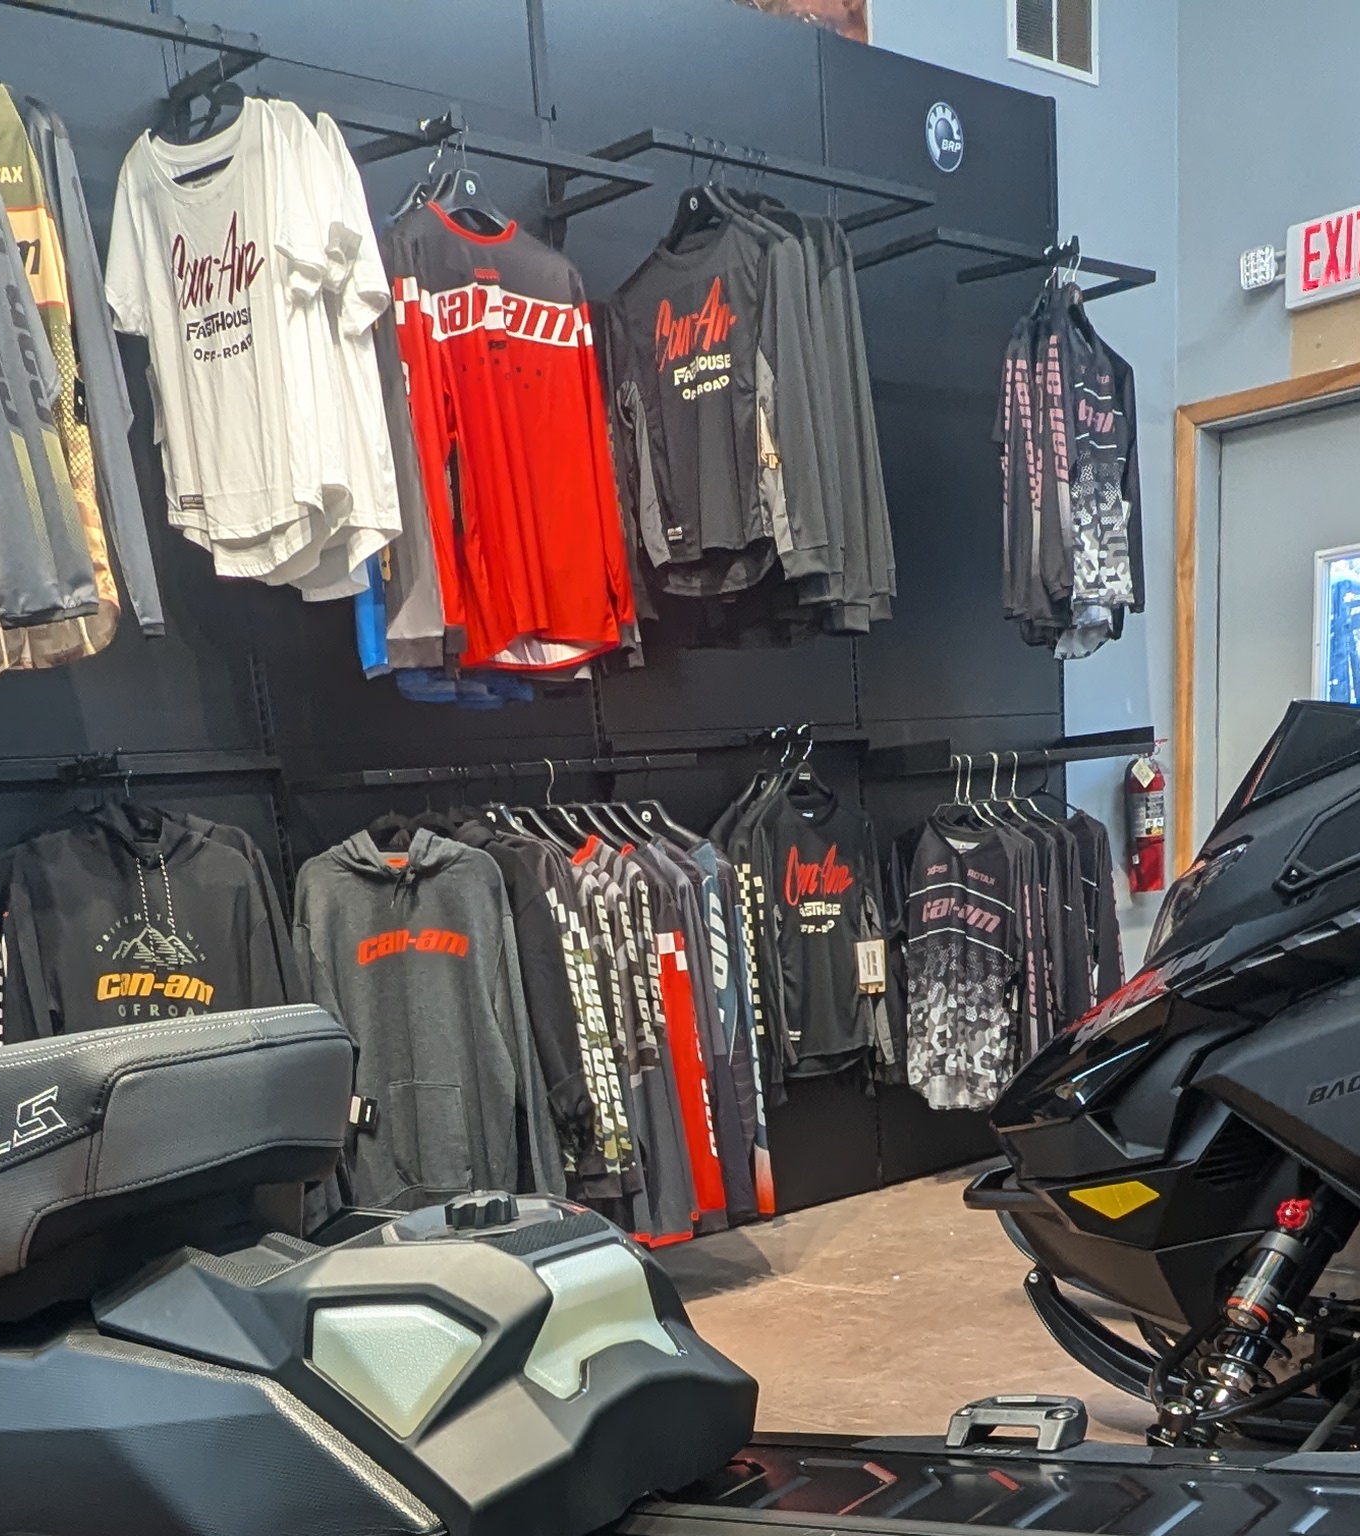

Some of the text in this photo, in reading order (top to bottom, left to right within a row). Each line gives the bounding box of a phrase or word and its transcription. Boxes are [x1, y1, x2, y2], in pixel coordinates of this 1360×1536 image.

[941, 138, 962, 155] BRP
[439, 286, 574, 342] can-am
[194, 334, 253, 362] OFF-ROAD
[967, 869, 996, 885] ROTAX
[357, 927, 469, 966] can-am
[97, 973, 214, 1006] can-am
